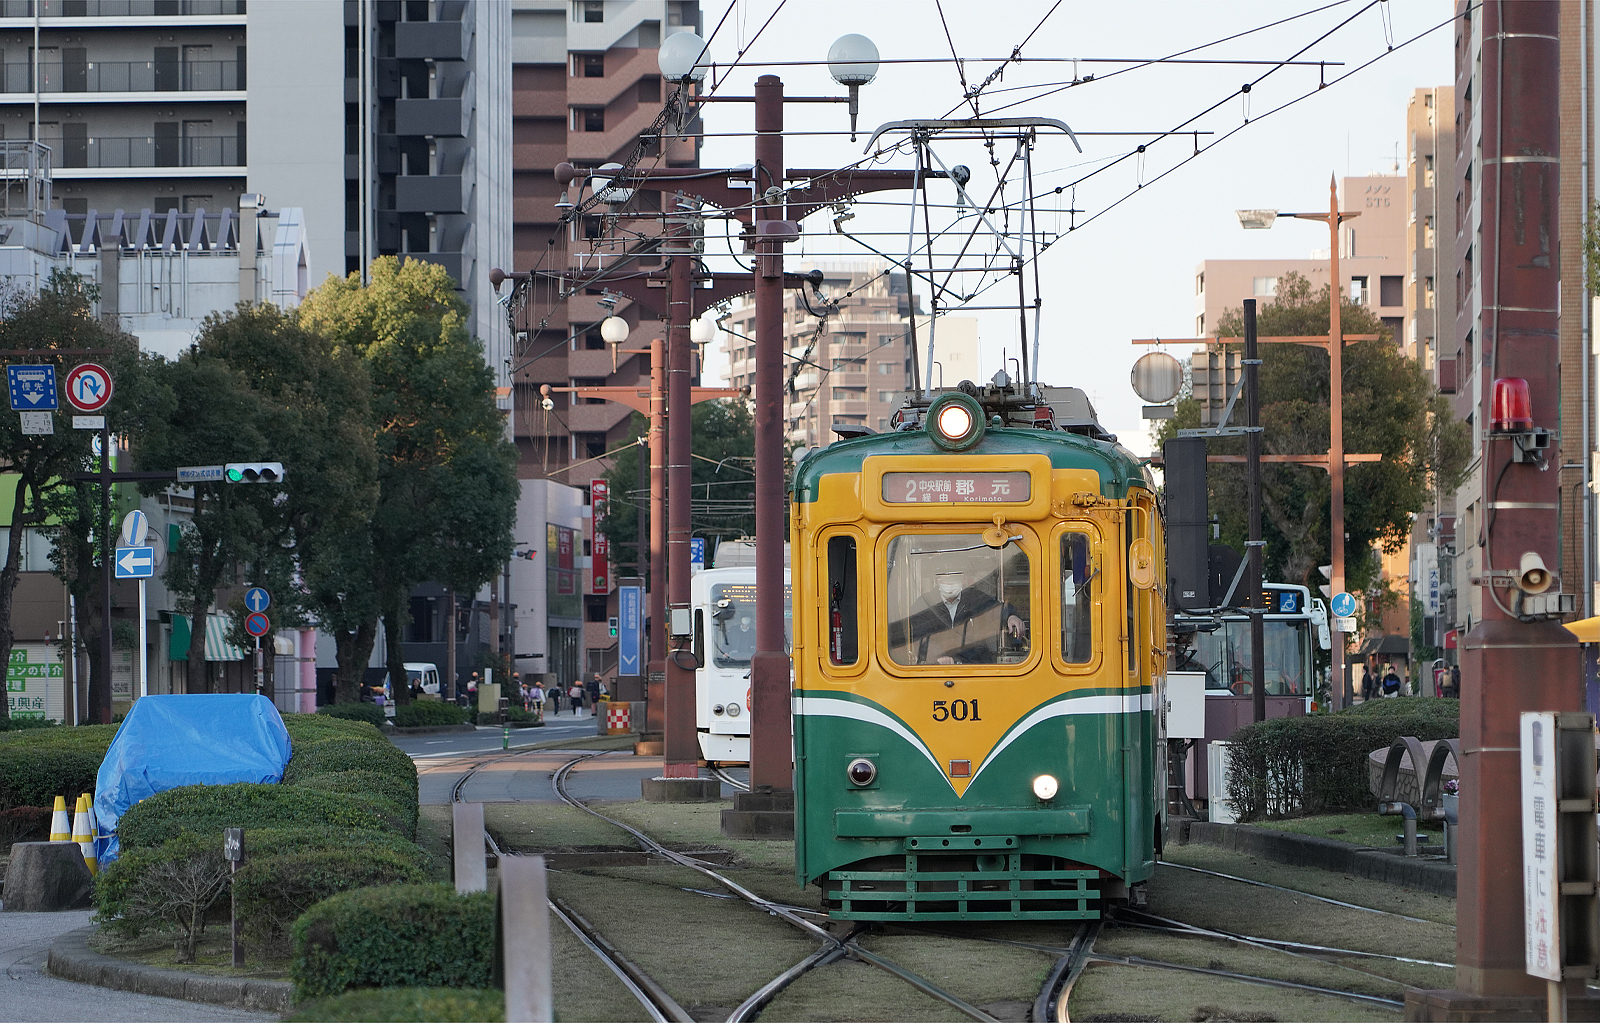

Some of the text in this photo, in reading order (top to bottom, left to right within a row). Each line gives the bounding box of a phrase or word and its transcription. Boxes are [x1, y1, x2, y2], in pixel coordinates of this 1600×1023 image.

[22, 382, 44, 391] 優先
[905, 480, 917, 502] 2
[919, 480, 952, 492] 中央駅前
[932, 699, 982, 722] 501
[1533, 796, 1550, 971] 電車に注意
